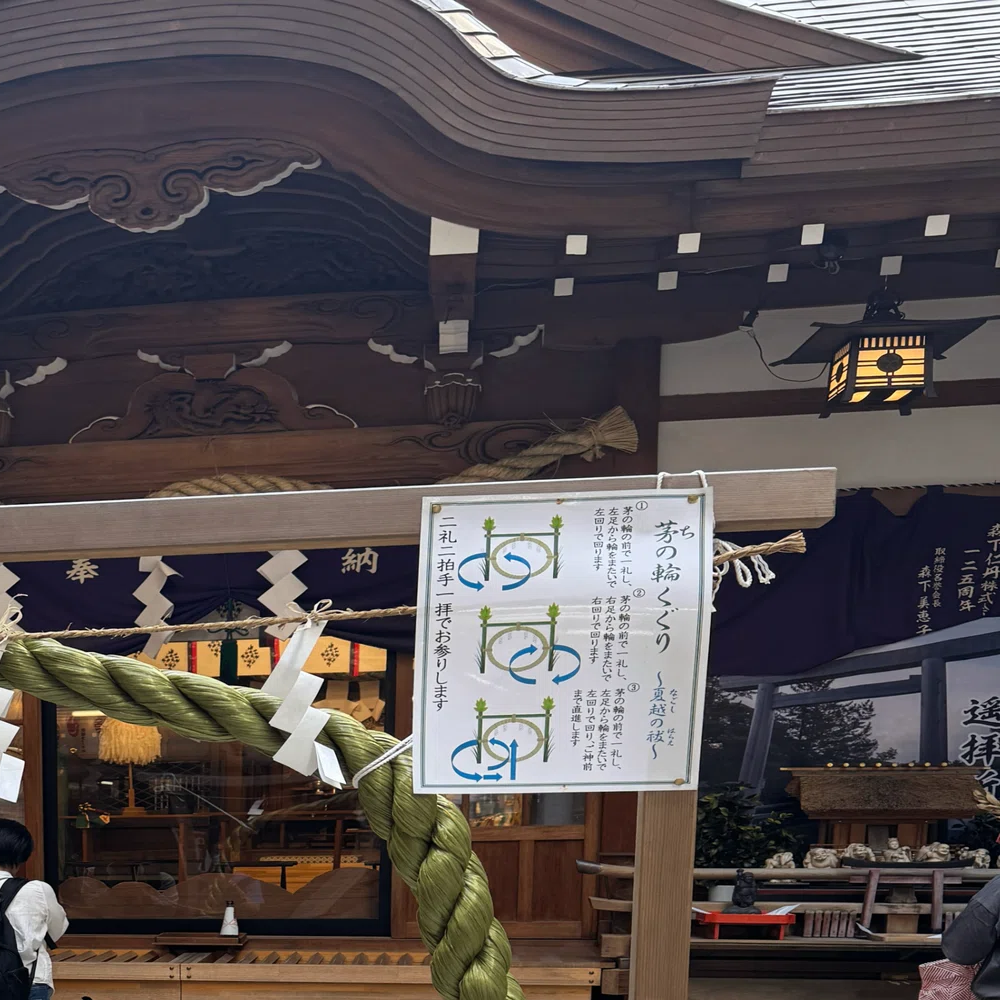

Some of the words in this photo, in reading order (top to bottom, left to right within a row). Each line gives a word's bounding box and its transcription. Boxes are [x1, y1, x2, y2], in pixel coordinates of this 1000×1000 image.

[65, 558, 99, 584] 奉
[341, 547, 379, 574] 納
[593, 508, 605, 571] 左回りで回ります
[606, 507, 619, 588] 左足から輪をまたいで
[620, 506, 633, 587] 茅の輪の前で一礼し、
[679, 525, 695, 540] ち
[432, 516, 457, 711] 二礼二拍手一拝でお参りします
[650, 519, 681, 654] 茅の輪くぐり
[932, 547, 946, 608] 取締役名誉会長
[957, 549, 980, 612] 一二五周年
[589, 596, 602, 664] 右回りで回ります
[601, 596, 617, 682] 右足から輪をまたいで
[616, 595, 631, 681] 茅の輪の前で一礼し、
[570, 689, 583, 747] まで直進します
[583, 689, 597, 771] 左回りで回り、ご神前
[597, 689, 611, 771] 左足から輪をまたいで
[611, 688, 625, 770] 茅の輪の前で一礼し、
